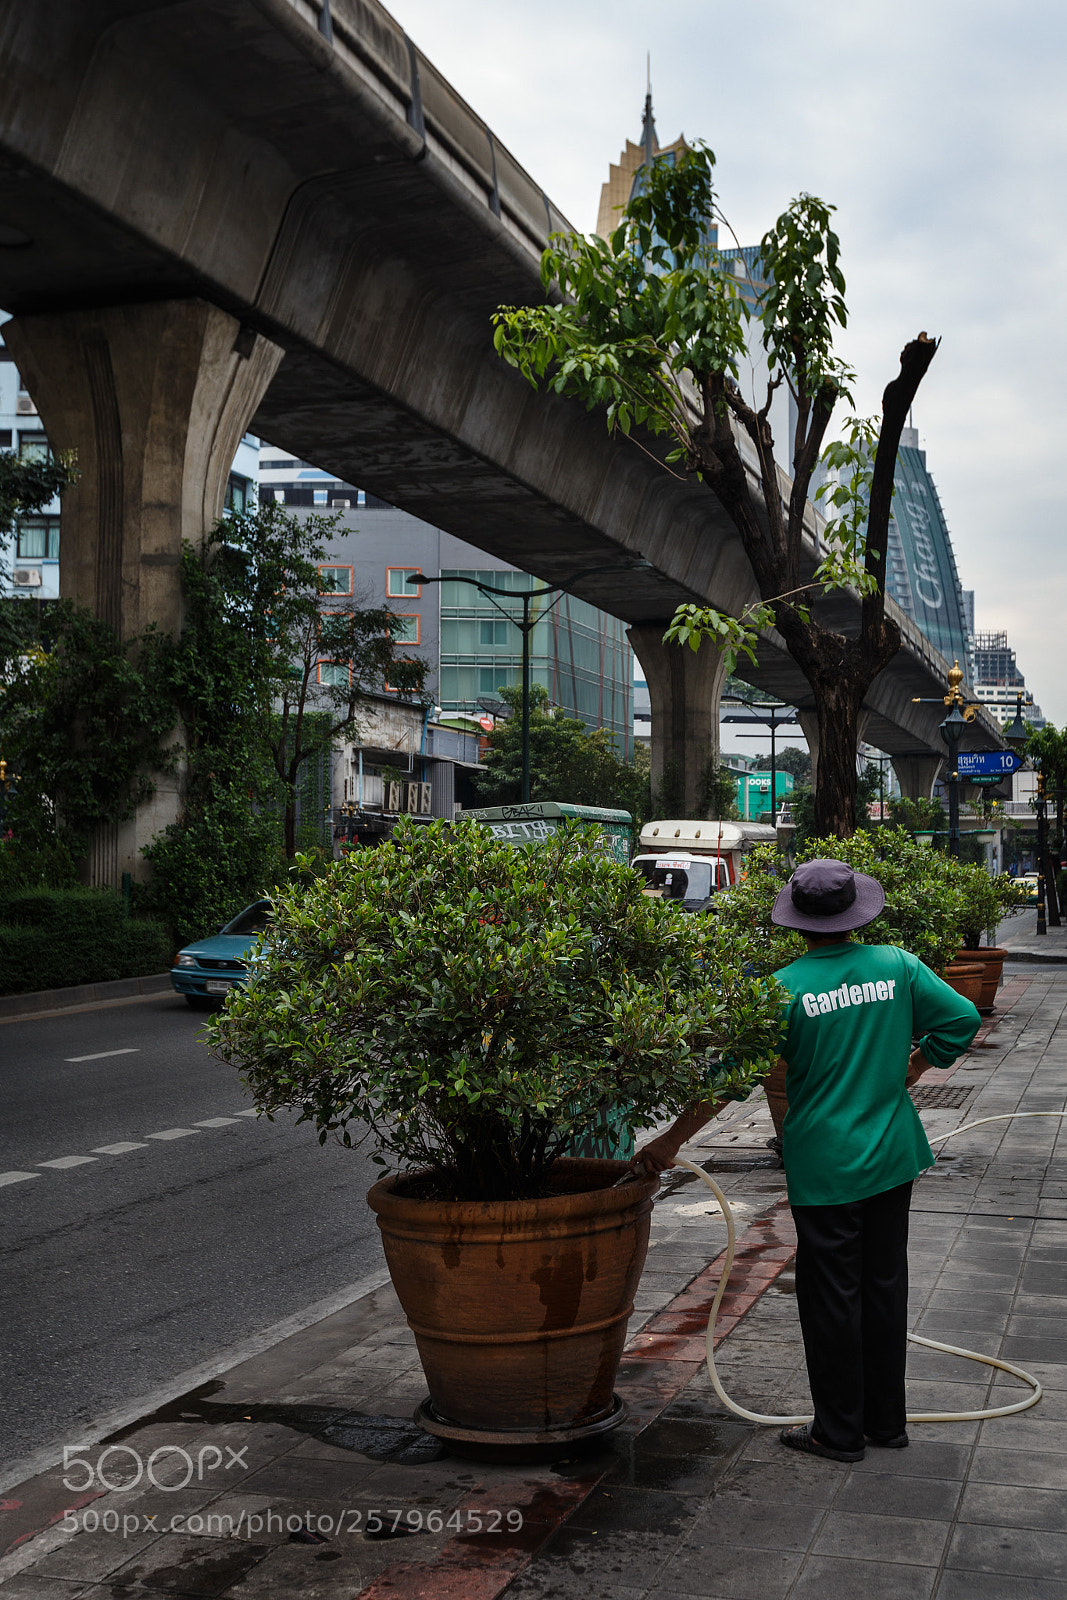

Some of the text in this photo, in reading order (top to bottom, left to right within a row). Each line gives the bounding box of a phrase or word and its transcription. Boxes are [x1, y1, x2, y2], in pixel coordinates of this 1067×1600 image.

[906, 501, 942, 609] Chang
[1000, 755, 1014, 767] 10
[748, 778, 771, 786] OOKS
[802, 980, 896, 1018] Gardener
